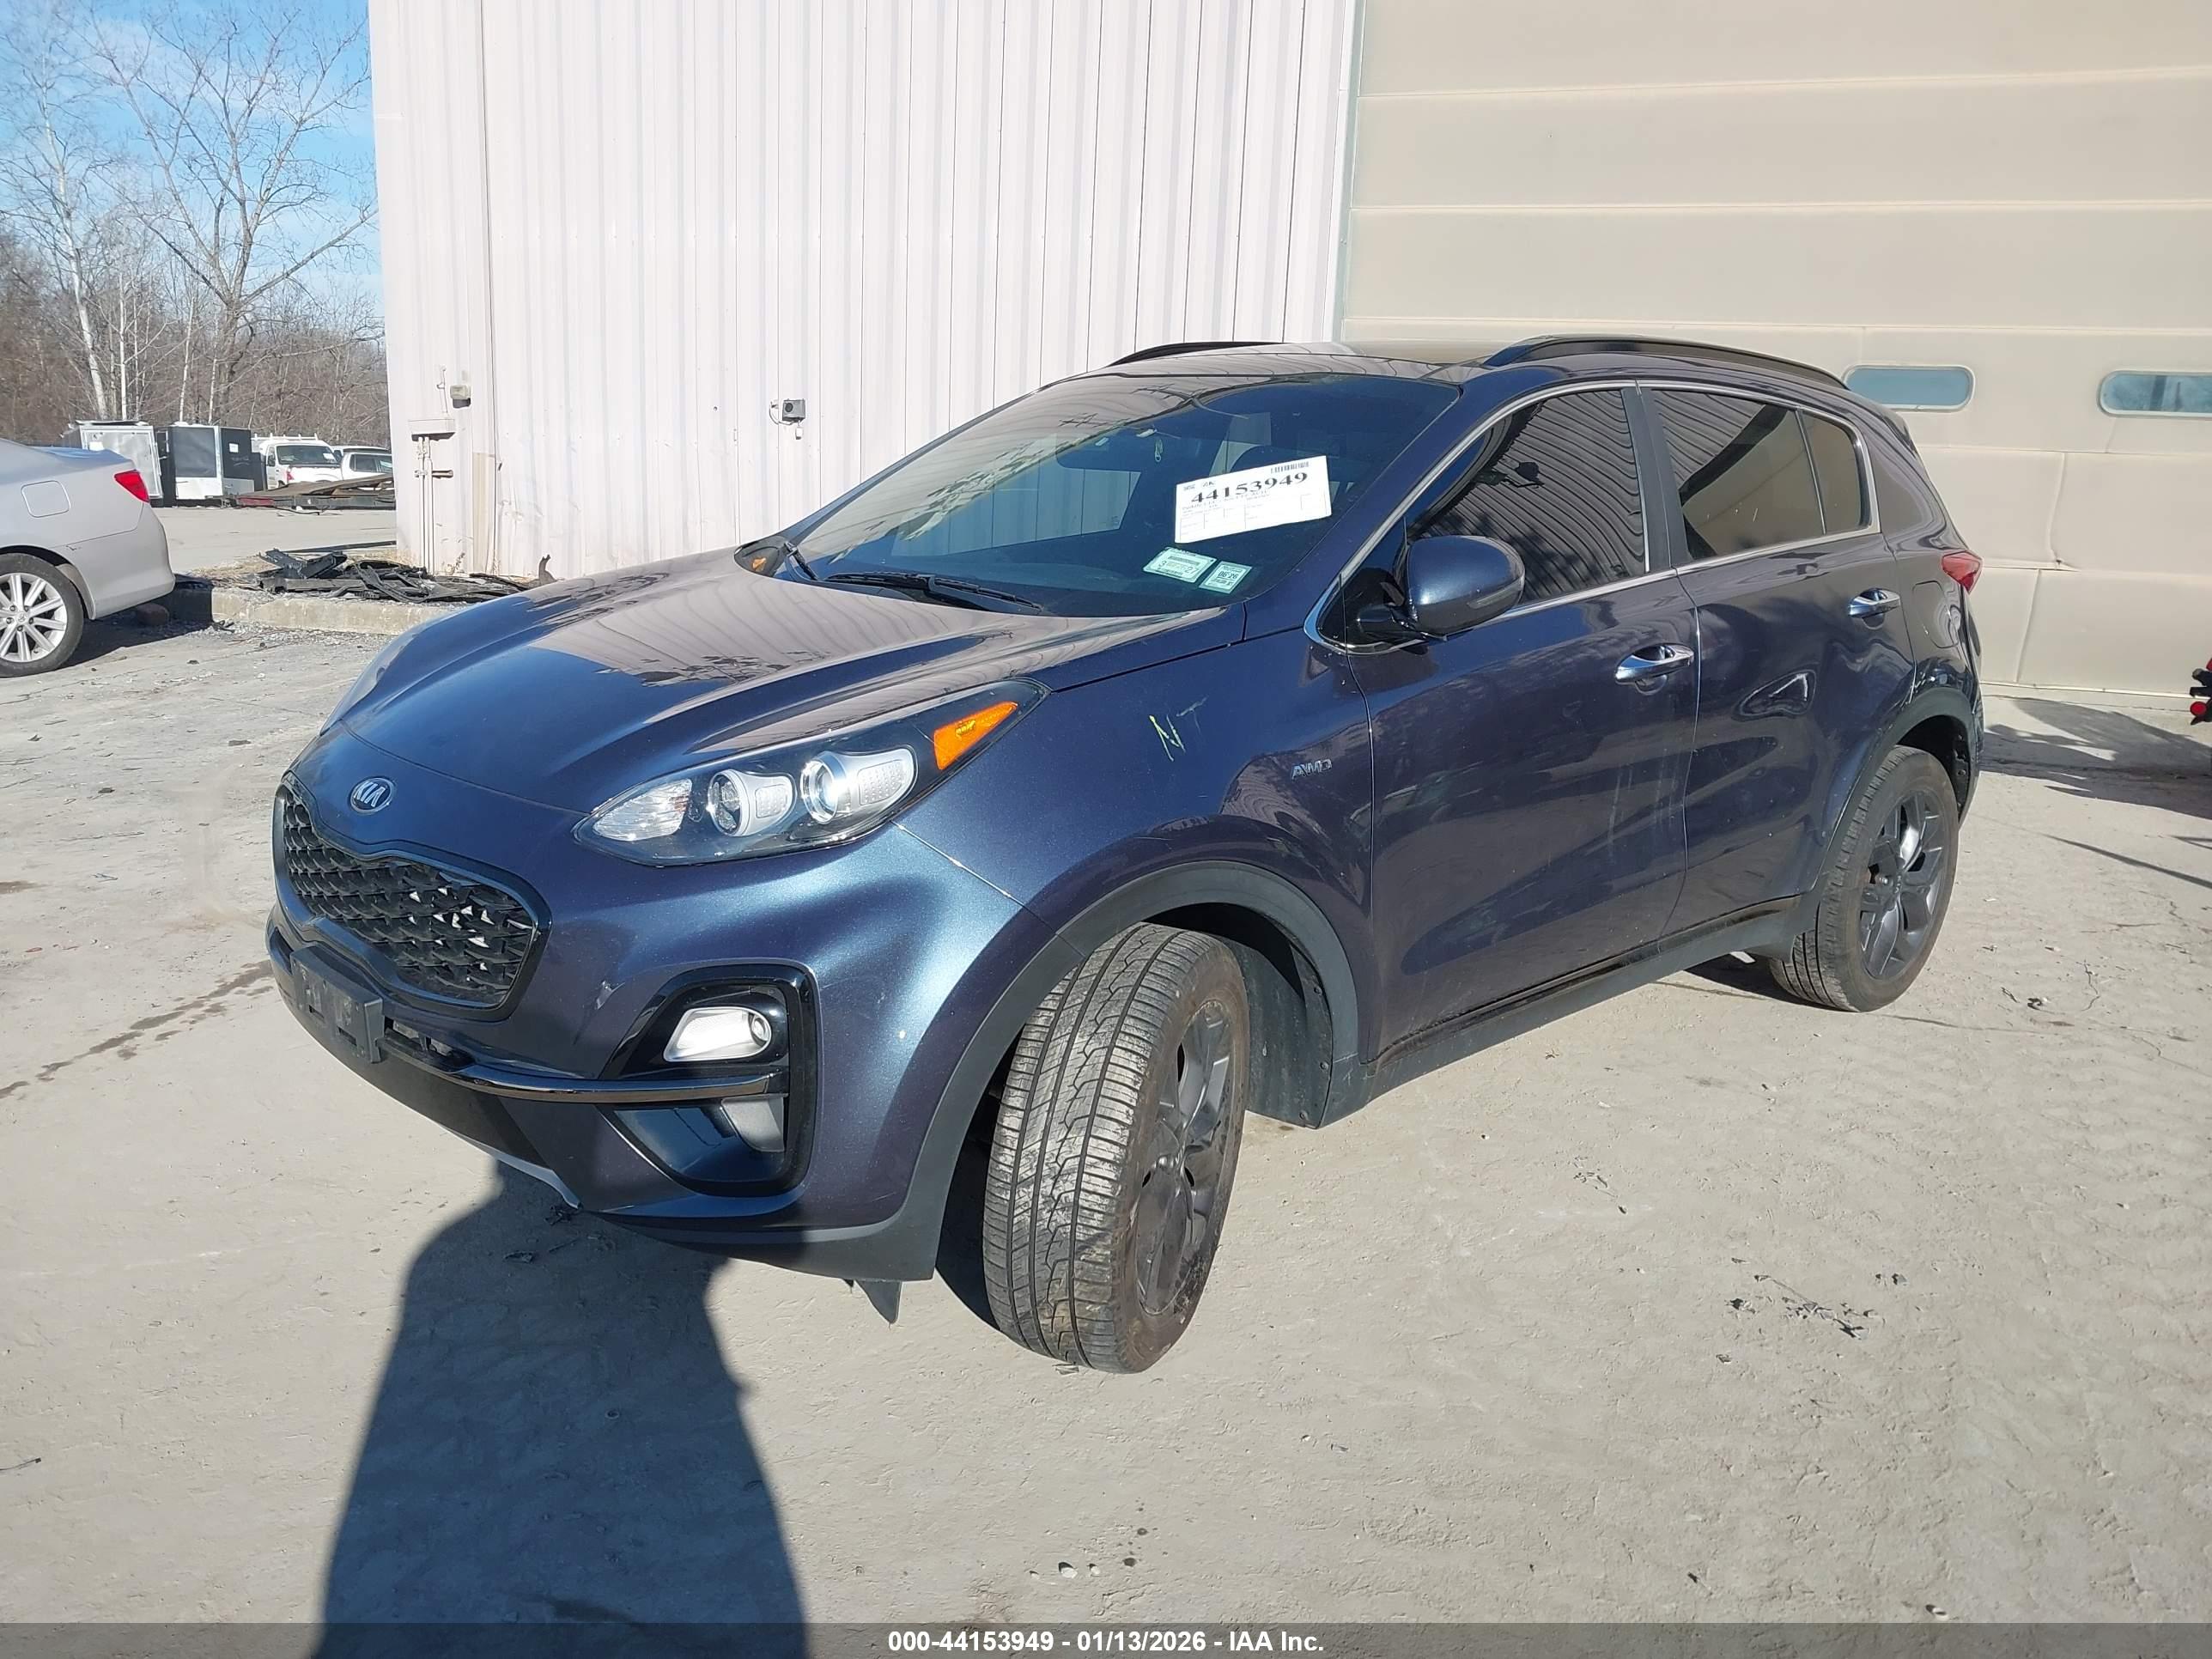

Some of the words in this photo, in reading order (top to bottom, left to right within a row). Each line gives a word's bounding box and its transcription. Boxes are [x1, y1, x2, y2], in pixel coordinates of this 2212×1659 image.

[1191, 471, 1309, 503] 44153949
[1291, 758, 1332, 781] AWD
[353, 781, 386, 807] KIA
